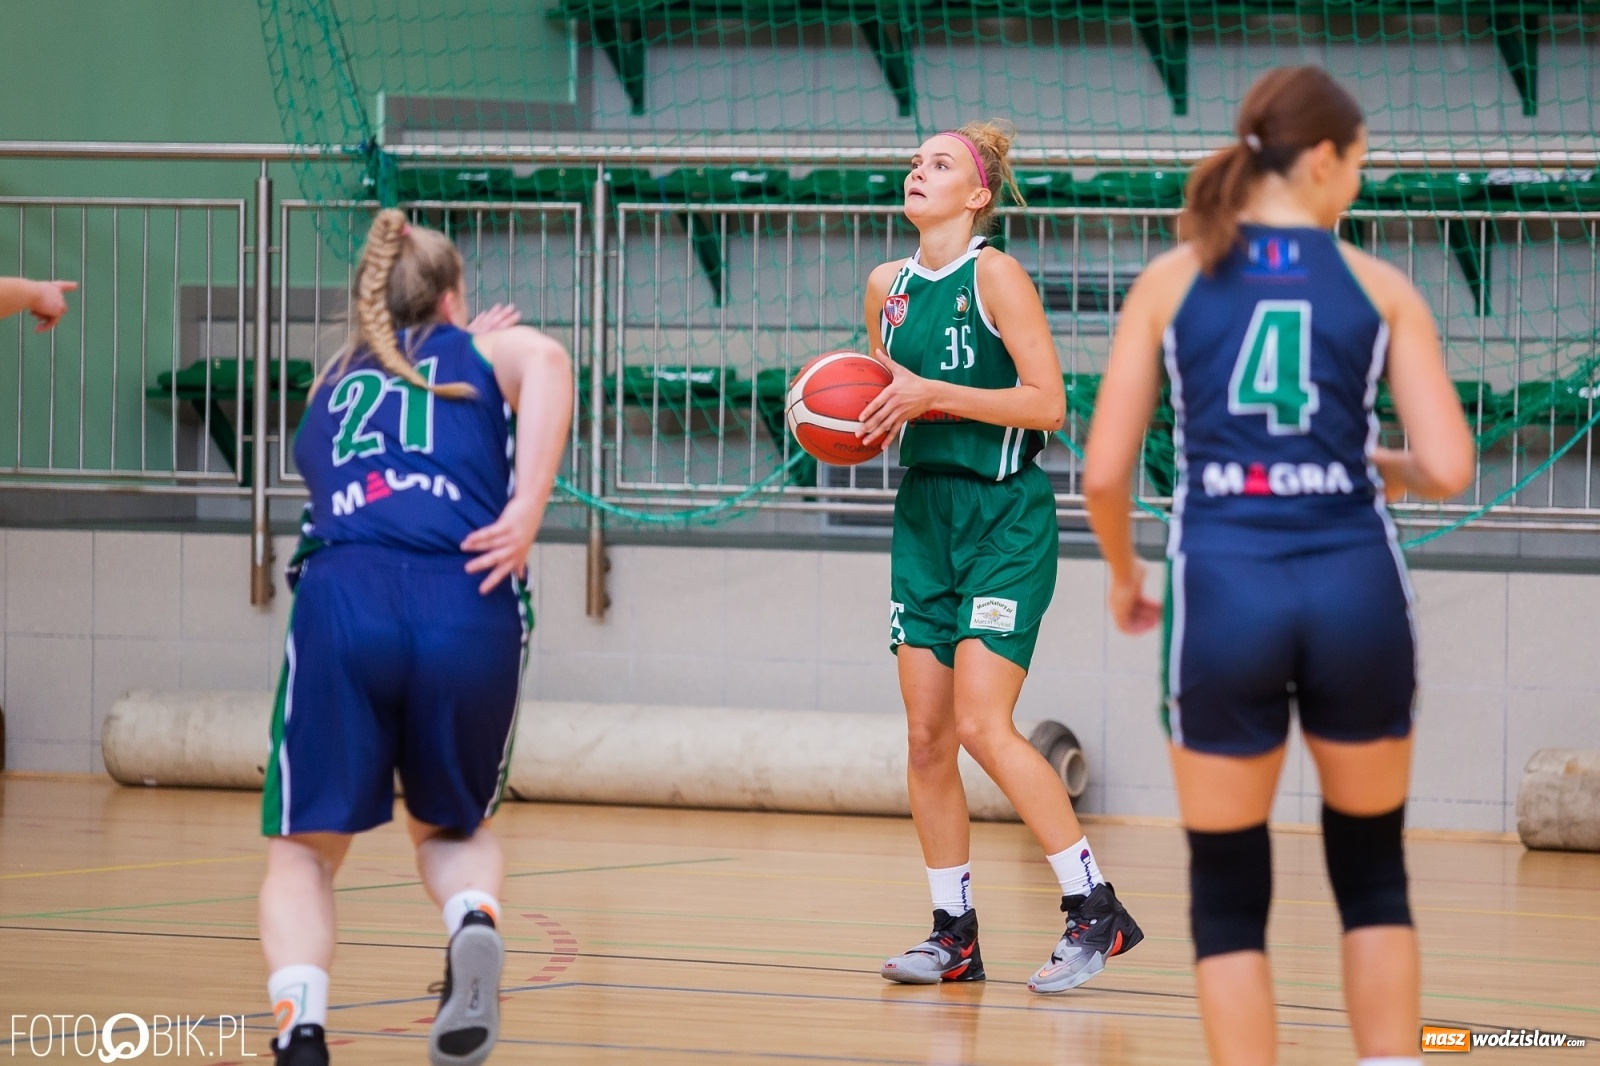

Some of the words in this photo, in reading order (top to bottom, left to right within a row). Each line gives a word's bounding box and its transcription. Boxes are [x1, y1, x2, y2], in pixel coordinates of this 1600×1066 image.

[940, 325, 975, 371] 35
[1228, 300, 1320, 435] 4
[328, 356, 438, 467] 21
[1202, 462, 1354, 497] MAGRA
